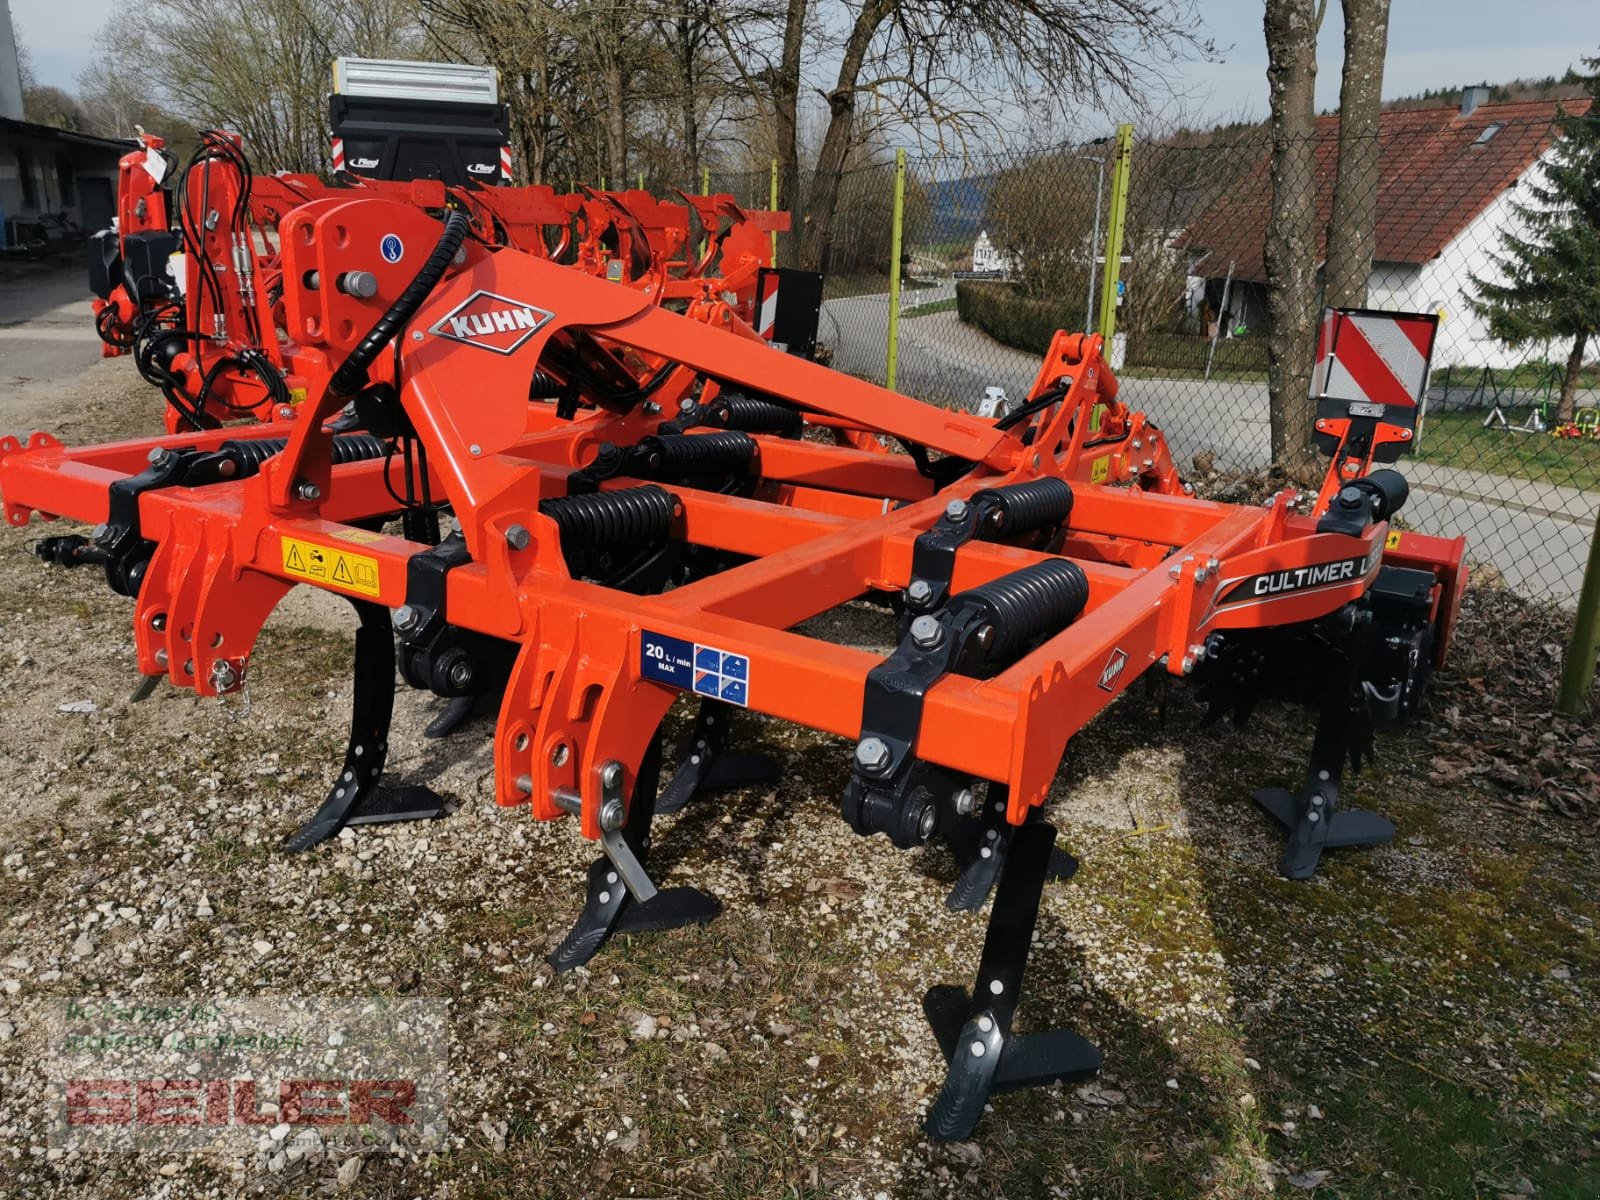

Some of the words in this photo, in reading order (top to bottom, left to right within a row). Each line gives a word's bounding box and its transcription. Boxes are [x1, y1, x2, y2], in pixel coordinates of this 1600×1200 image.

[449, 307, 536, 338] KUHN
[1254, 560, 1353, 595] CULTIMER
[645, 643, 664, 660] 20
[658, 662, 675, 673] MAX
[1102, 655, 1125, 686] KUHN
